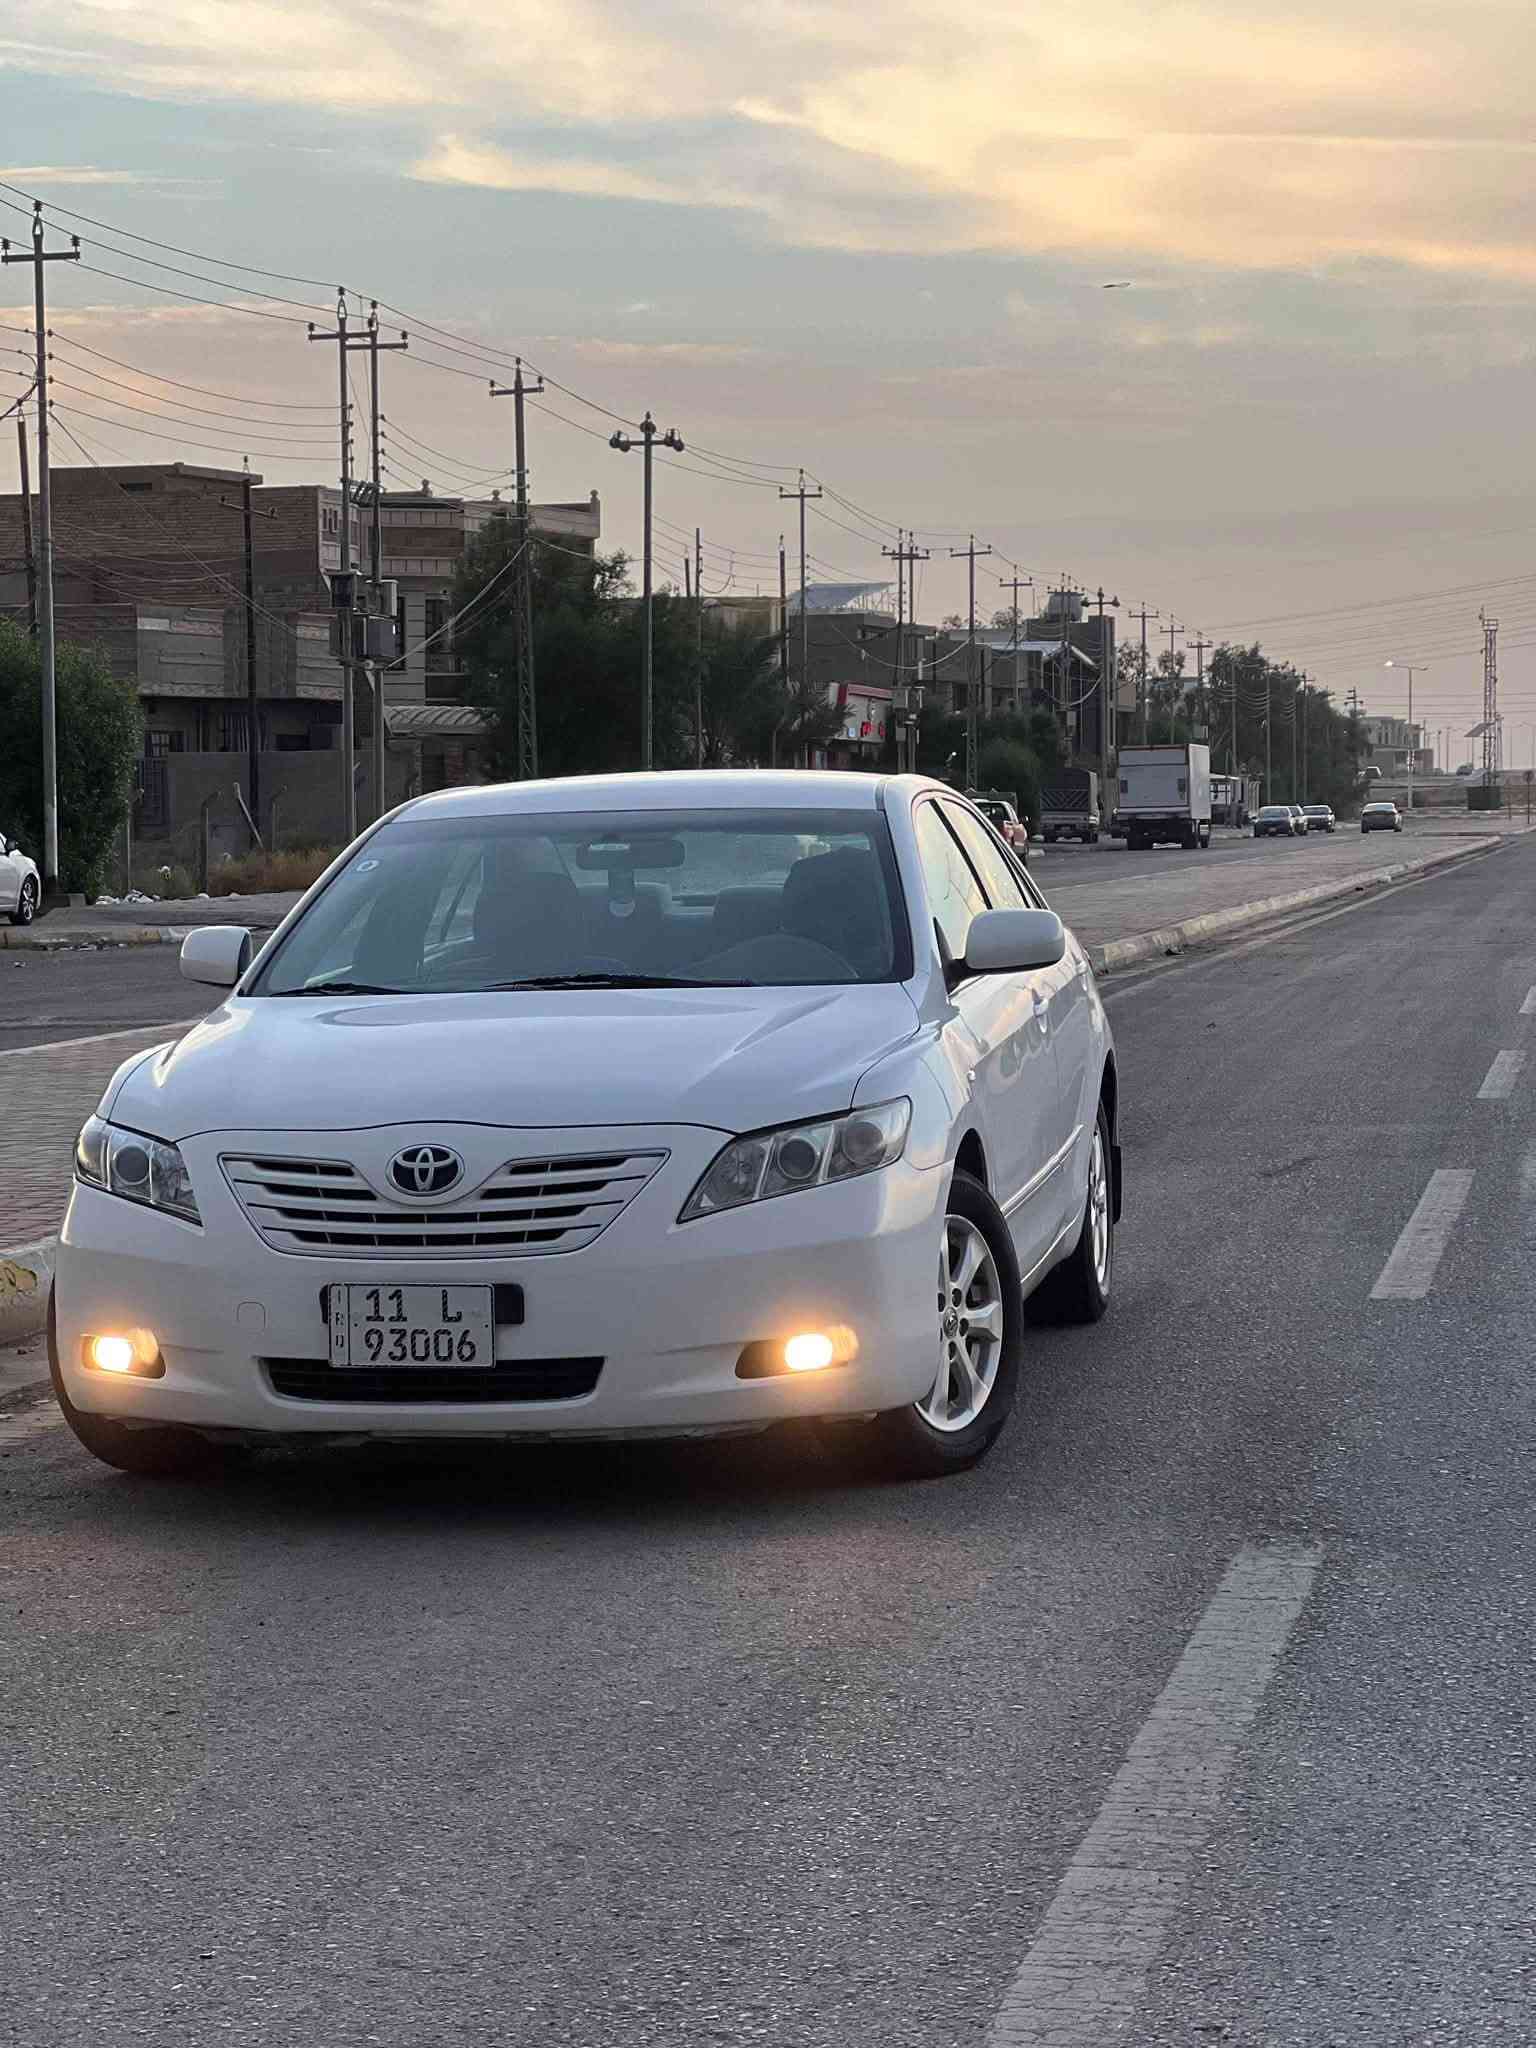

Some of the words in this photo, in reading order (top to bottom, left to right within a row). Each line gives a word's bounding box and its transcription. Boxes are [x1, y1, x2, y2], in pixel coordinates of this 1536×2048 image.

[366, 1289, 407, 1322] 11
[441, 1289, 462, 1323] L
[364, 1328, 476, 1362] 93006
